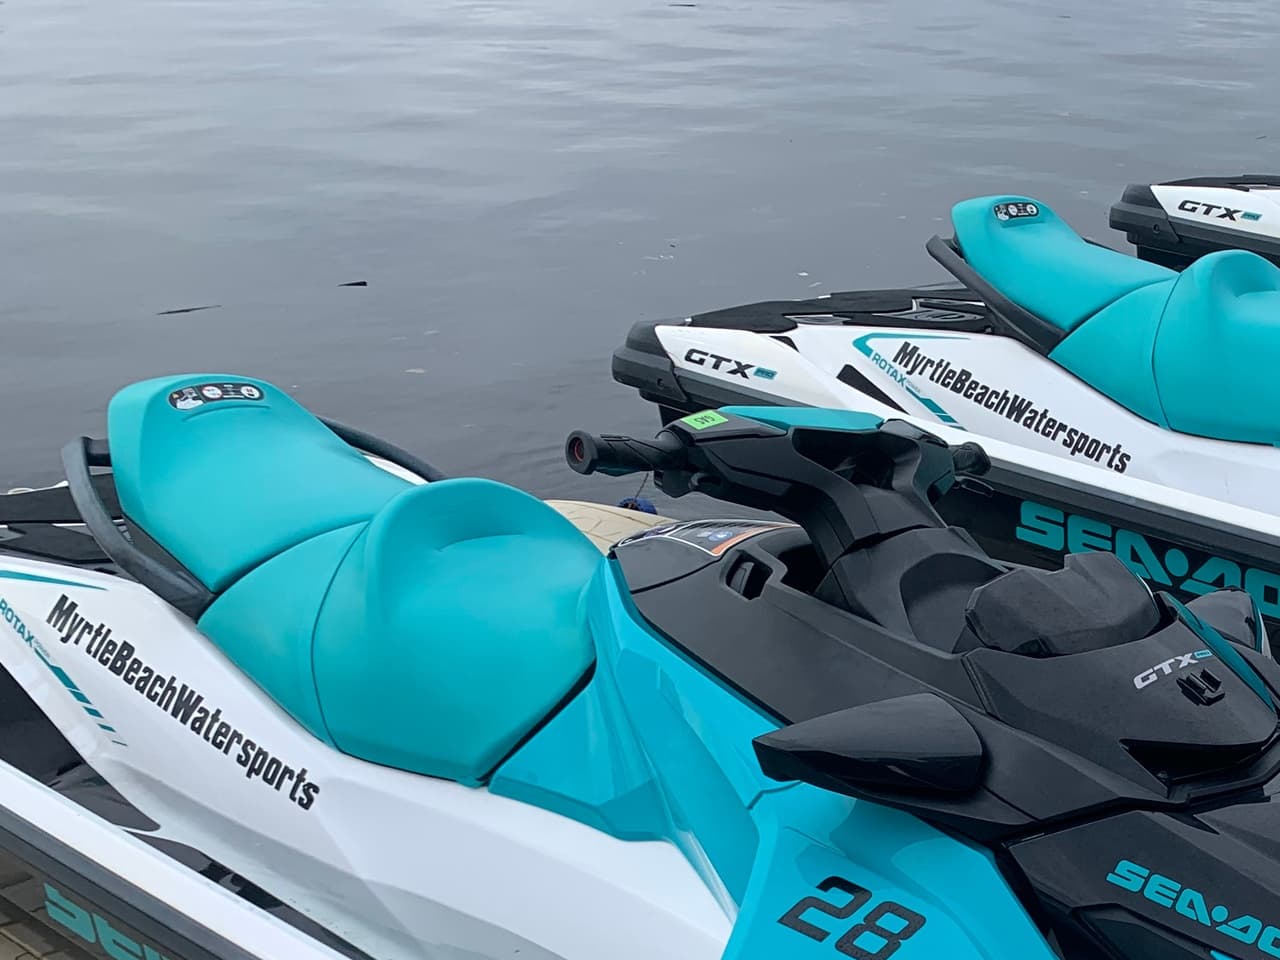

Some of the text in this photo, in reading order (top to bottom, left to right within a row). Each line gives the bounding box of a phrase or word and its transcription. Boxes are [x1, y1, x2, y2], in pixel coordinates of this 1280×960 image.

[1178, 200, 1243, 221] GTX
[684, 348, 756, 380] GTX
[872, 353, 907, 387] ROTAX
[892, 340, 1131, 475] MyrtleBeachWatersports
[1133, 652, 1199, 690] GTX
[46, 594, 320, 811] MyrtleBeachWatersports
